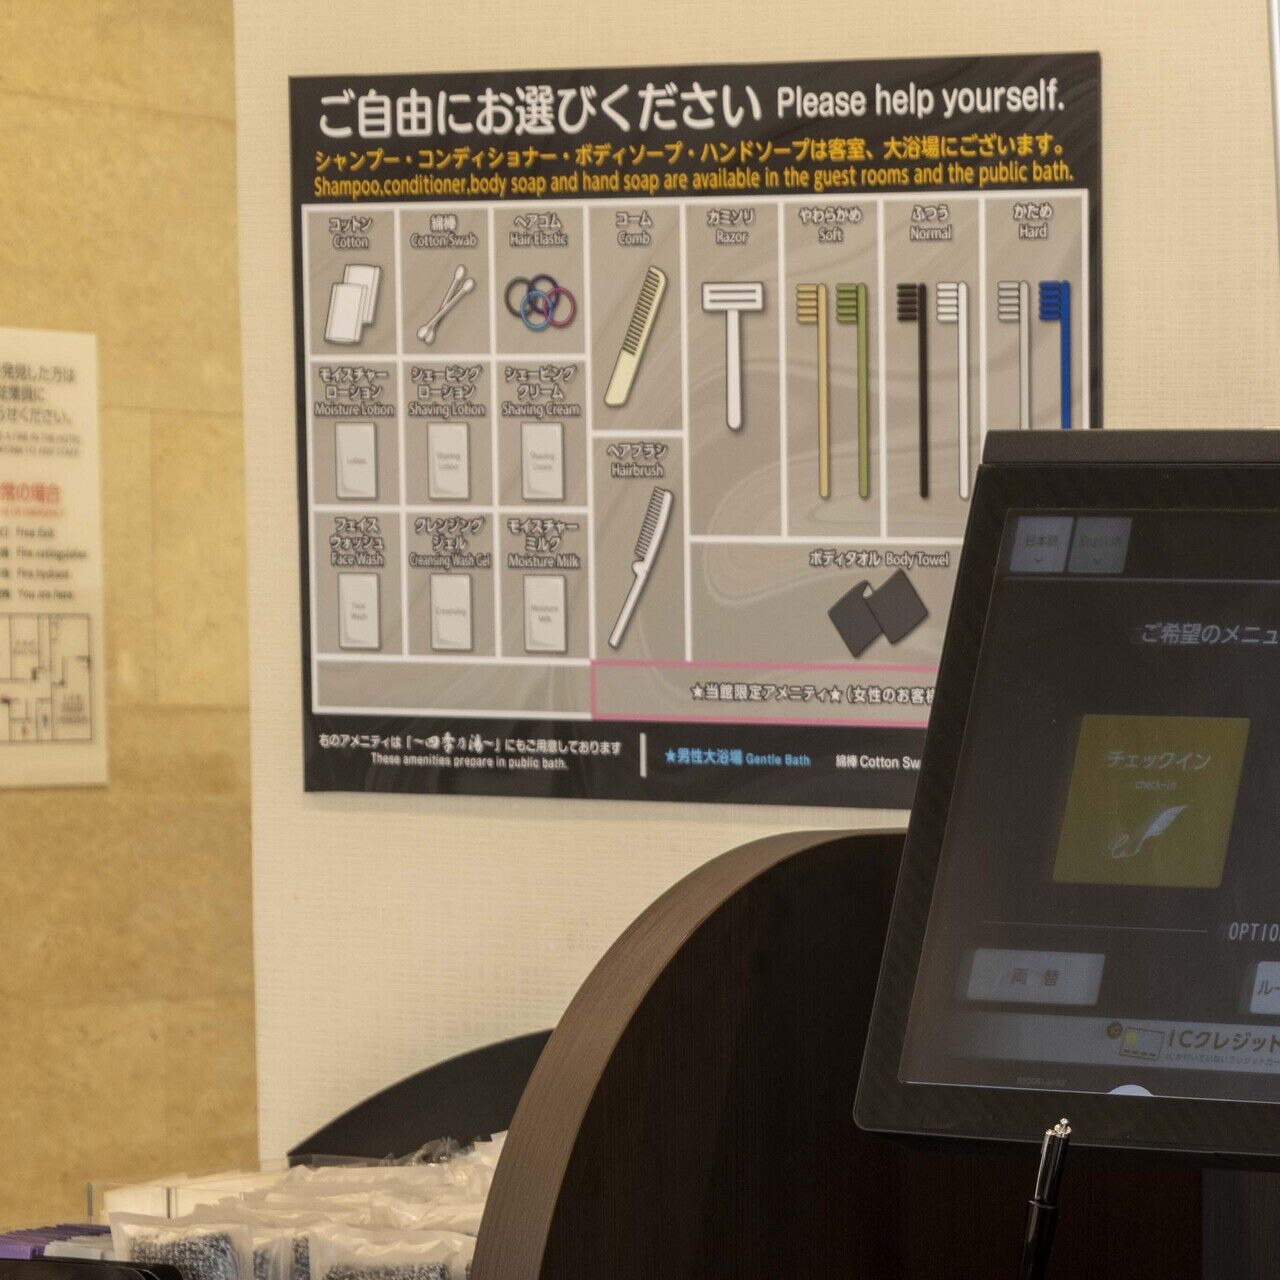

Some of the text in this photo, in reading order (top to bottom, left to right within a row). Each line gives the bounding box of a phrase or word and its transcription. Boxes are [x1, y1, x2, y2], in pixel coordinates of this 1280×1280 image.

[318, 77, 1065, 138] ご自由にお選びください Please help yourself.
[511, 160, 1074, 197] soap and hand soap are available in the guest rooms and the public bath.
[615, 211, 653, 228] コーム
[706, 208, 756, 226] カミソリ
[799, 206, 862, 224] やわらかめ
[911, 204, 950, 222] ふつう
[1012, 202, 1053, 220] かため
[328, 216, 374, 234] コットン
[513, 212, 563, 231] ヘアゴム
[410, 232, 446, 248] Cotton
[616, 230, 651, 246] Comb
[716, 229, 748, 245] Razor
[818, 227, 843, 243] Soft
[910, 225, 952, 242] Normal
[1019, 223, 1048, 240] Hard
[332, 233, 369, 250] Cotton
[408, 402, 485, 420] Shaving Lotion
[502, 402, 581, 420] Shaving Cream
[612, 463, 664, 478] Hairbrush
[507, 554, 554, 568] Moisture
[885, 550, 949, 568] Body Towel
[370, 751, 400, 766] These
[860, 755, 899, 769] Cotton
[1107, 750, 1212, 771] チェックイン
